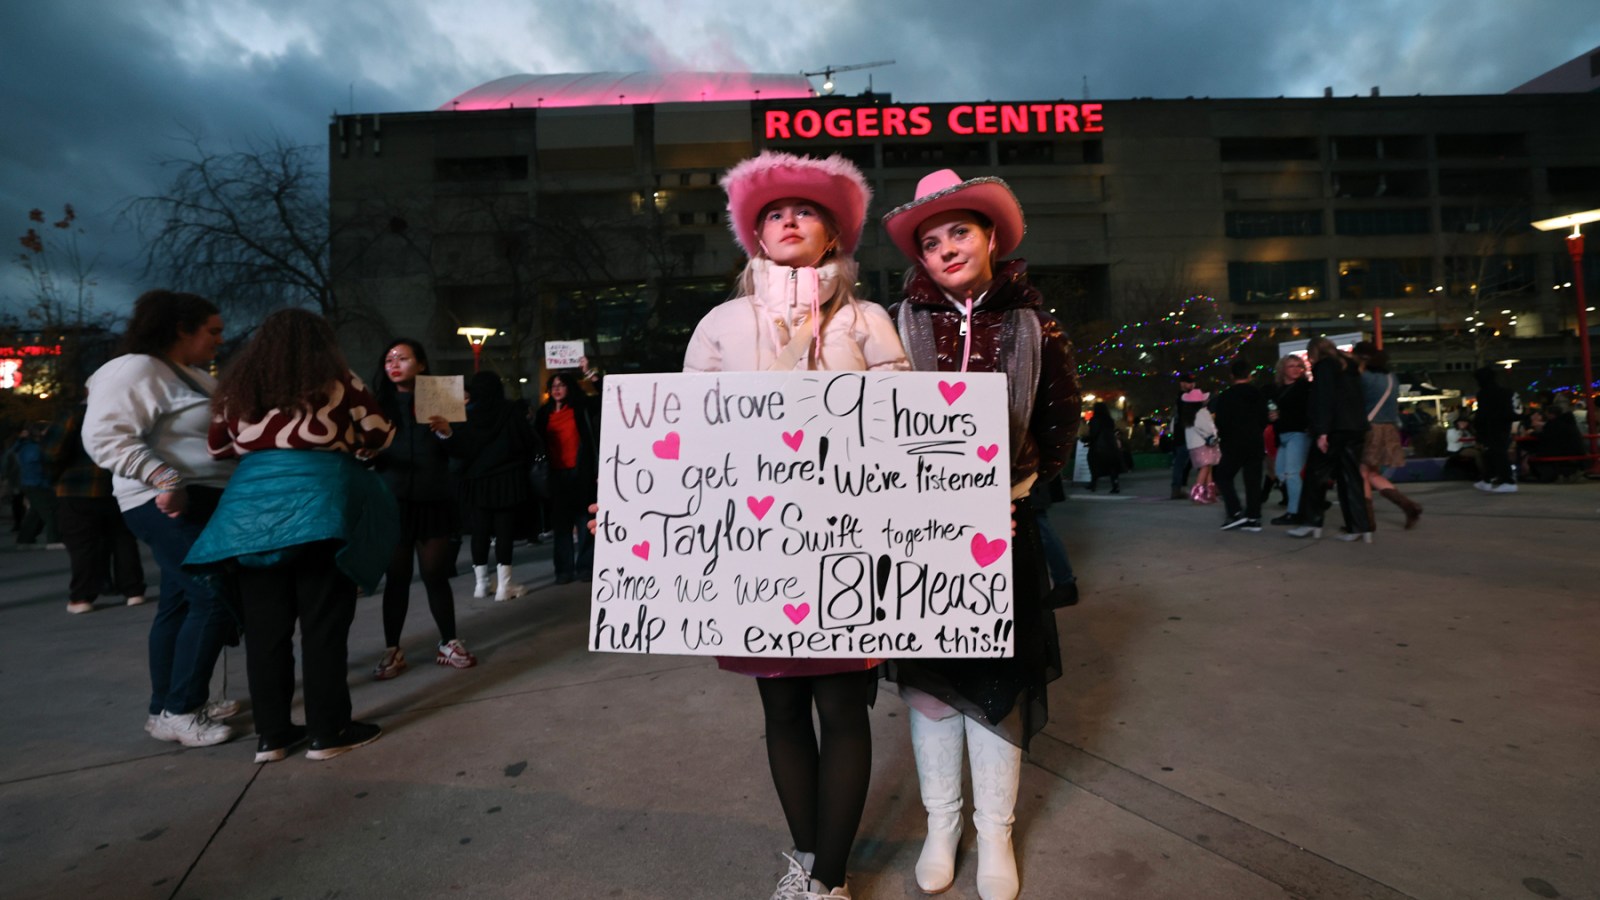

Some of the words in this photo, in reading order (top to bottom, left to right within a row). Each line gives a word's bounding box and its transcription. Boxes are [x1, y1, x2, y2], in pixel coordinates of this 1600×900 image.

[765, 106, 932, 139] ROGERS
[948, 103, 1104, 135] CENTRE
[617, 381, 681, 429] We
[703, 378, 785, 425] drove
[824, 373, 866, 447] 9
[893, 388, 977, 438] hours
[606, 444, 654, 502] to
[682, 452, 738, 516] get
[758, 436, 829, 485] here!
[834, 463, 907, 497] We've
[917, 455, 998, 493] listened
[599, 510, 627, 543] to
[640, 498, 773, 576] Taylor
[780, 502, 863, 555] Swift
[882, 518, 976, 557] together
[674, 574, 718, 603] we
[735, 574, 806, 606] were
[896, 560, 1009, 621] Please
[594, 604, 666, 654] help
[681, 617, 723, 650] us
[744, 625, 923, 657] experience
[935, 618, 1013, 656] this!!
